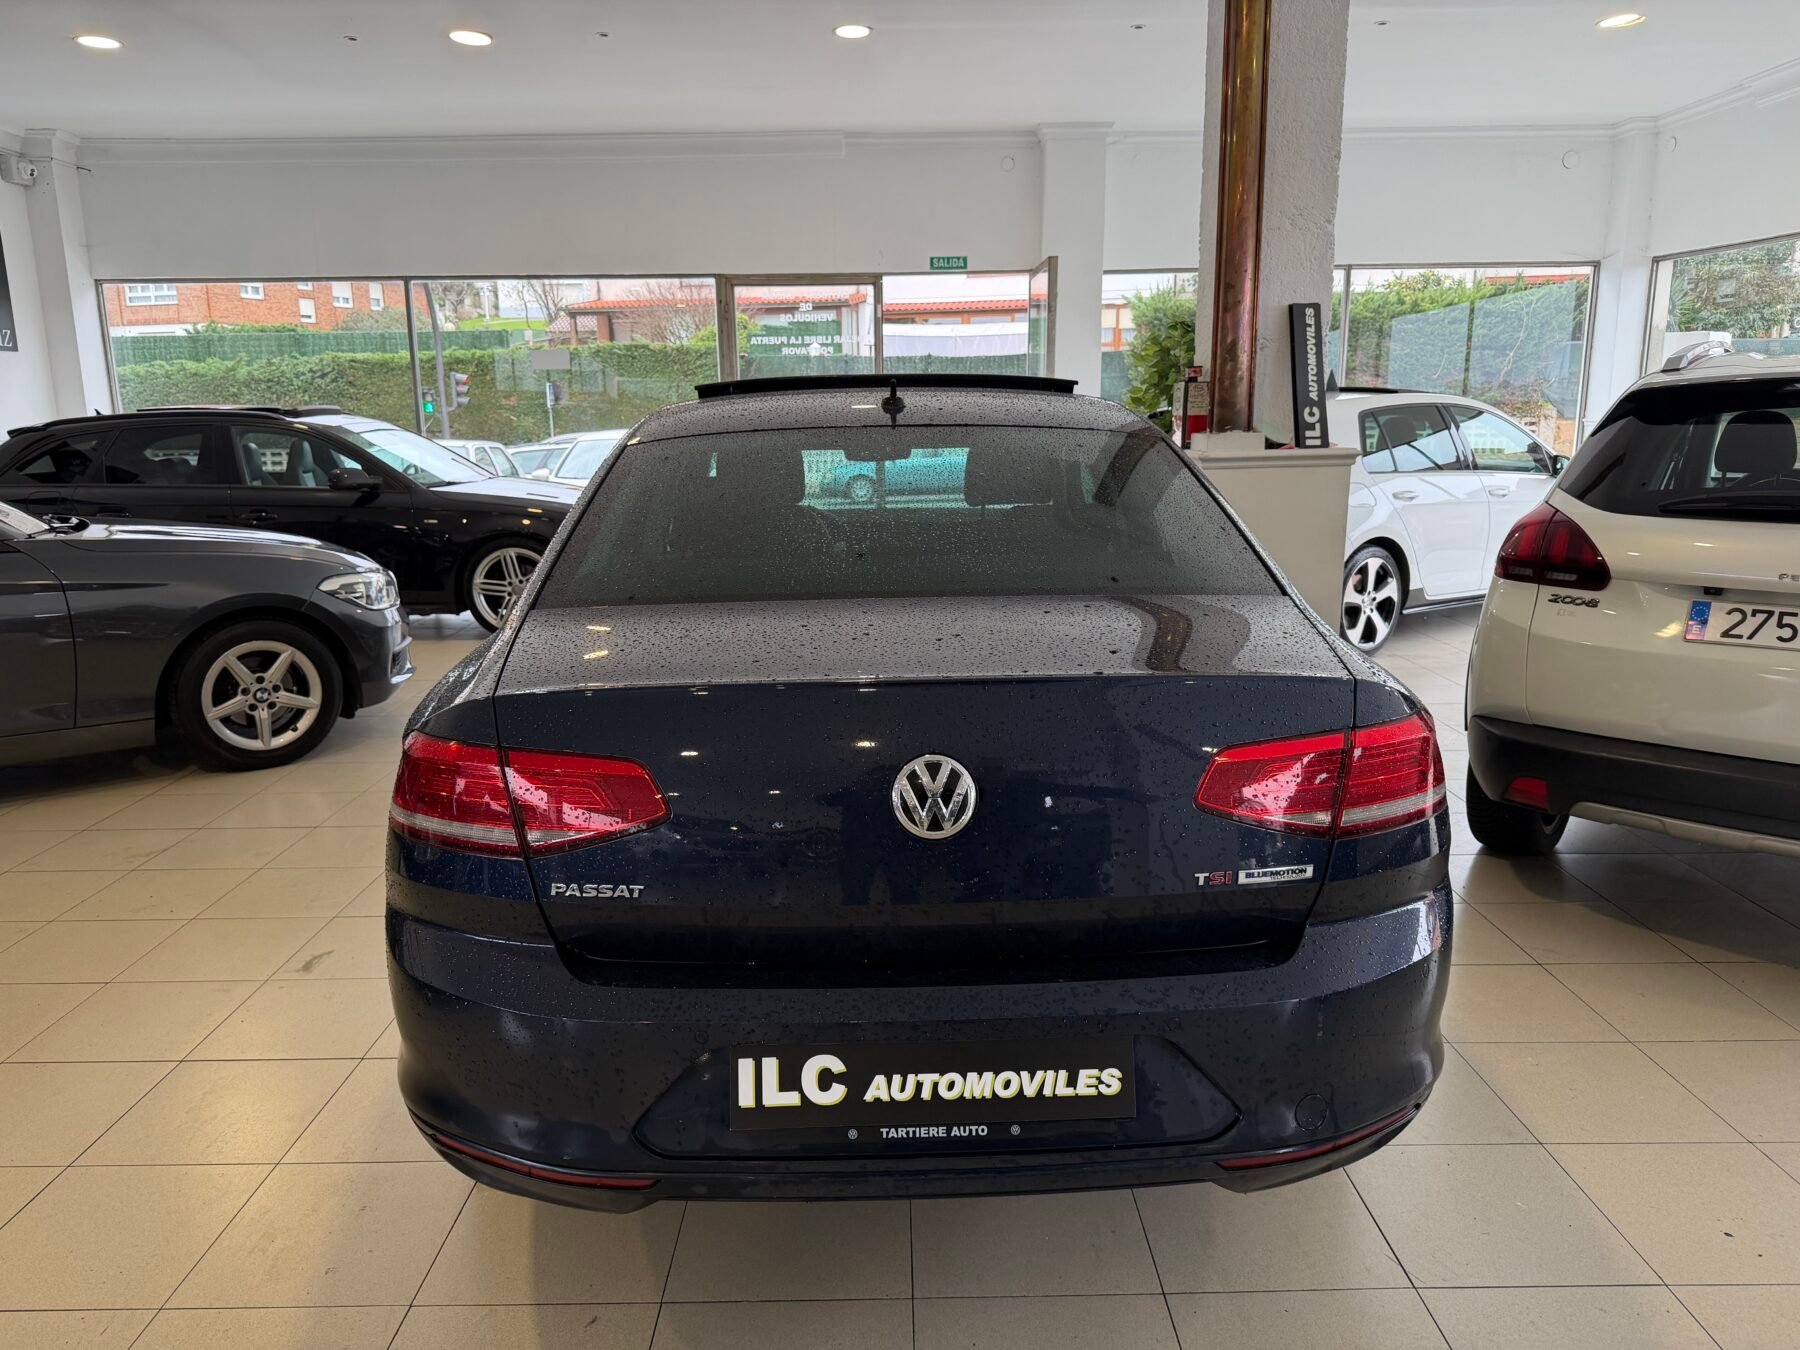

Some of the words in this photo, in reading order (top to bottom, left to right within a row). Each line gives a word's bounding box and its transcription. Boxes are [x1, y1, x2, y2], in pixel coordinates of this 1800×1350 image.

[932, 258, 965, 268] SALIDA
[1305, 307, 1319, 401] AUTOMOVILES
[1303, 406, 1322, 446] ILC
[1547, 593, 1600, 608] 2008
[1719, 607, 1800, 643] 275
[1194, 871, 1233, 886] TSI
[1245, 867, 1307, 879] BLUEMOTION
[550, 883, 645, 898] PASSAT
[737, 1054, 848, 1109] ILC
[863, 1067, 1123, 1102] AUTOMOVILES
[880, 1126, 948, 1139] TARTIERE
[950, 1125, 988, 1137] AUTO
